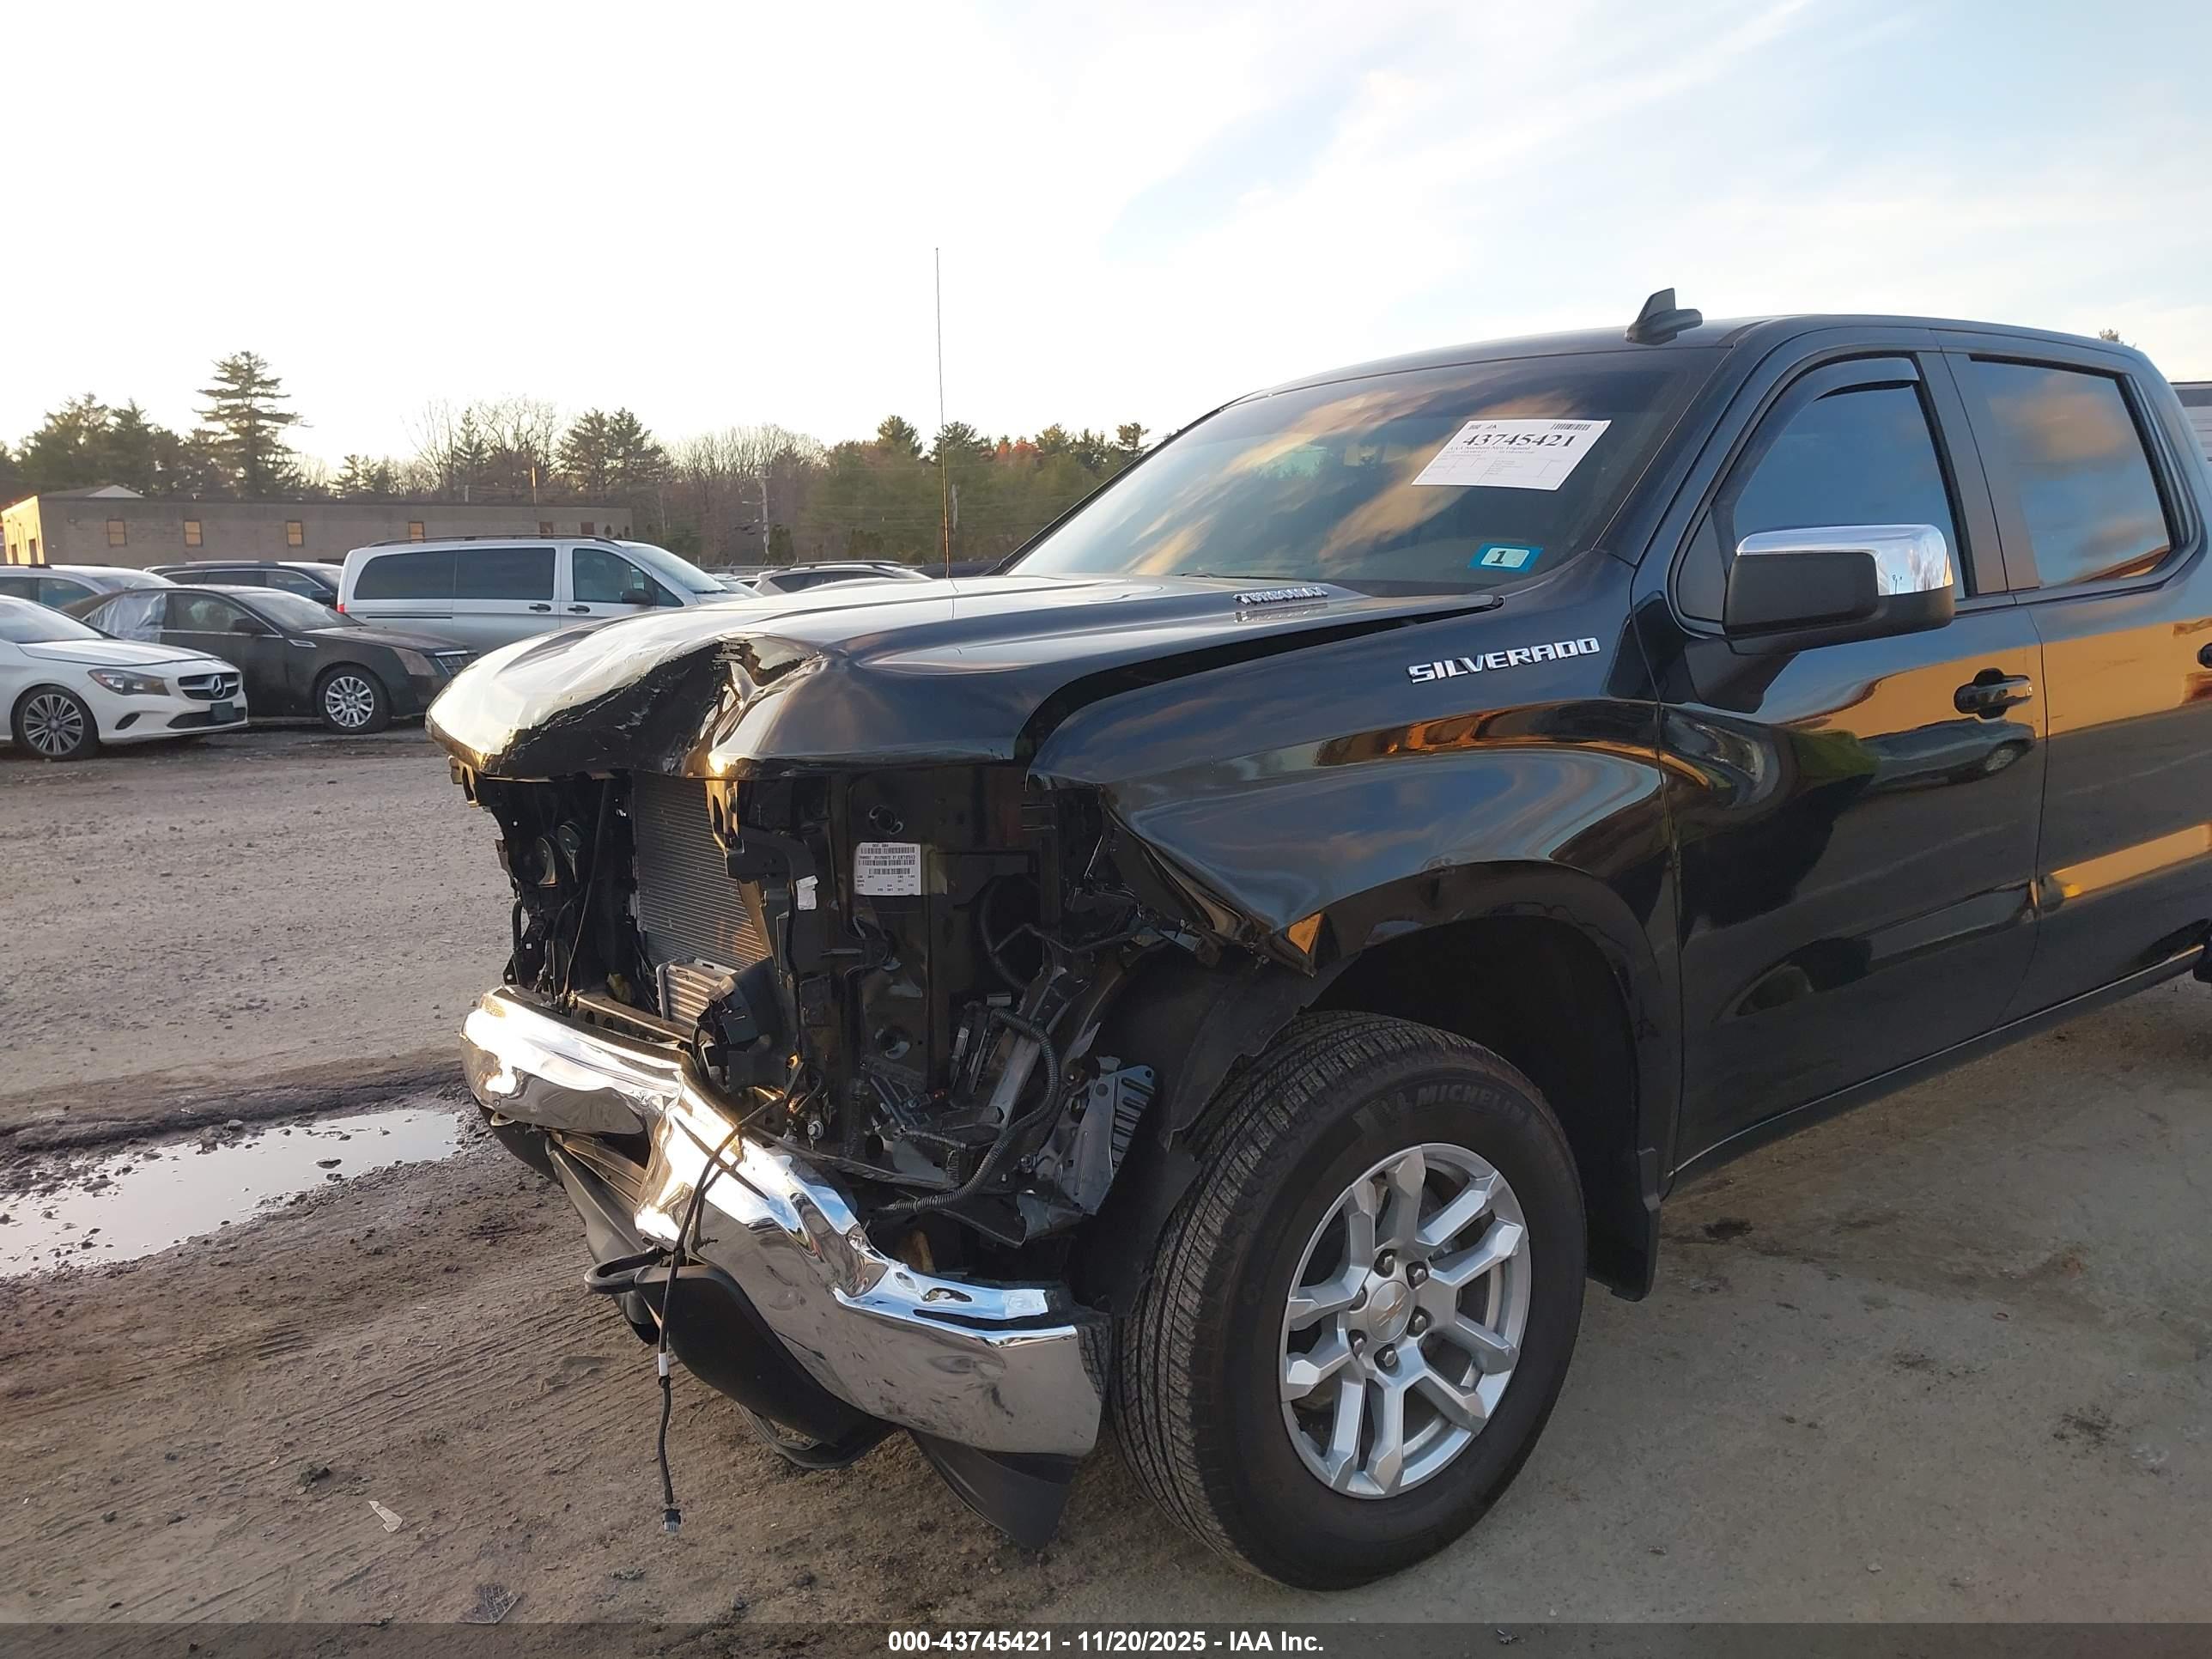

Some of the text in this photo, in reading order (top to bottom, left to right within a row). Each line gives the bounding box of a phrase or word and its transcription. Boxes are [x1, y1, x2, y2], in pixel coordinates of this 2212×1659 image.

[1463, 433, 1577, 447] 43745421
[1491, 550, 1506, 563] 1
[1407, 637, 1601, 684] SILVERADO
[1417, 1085, 1527, 1122] MICHELIN
